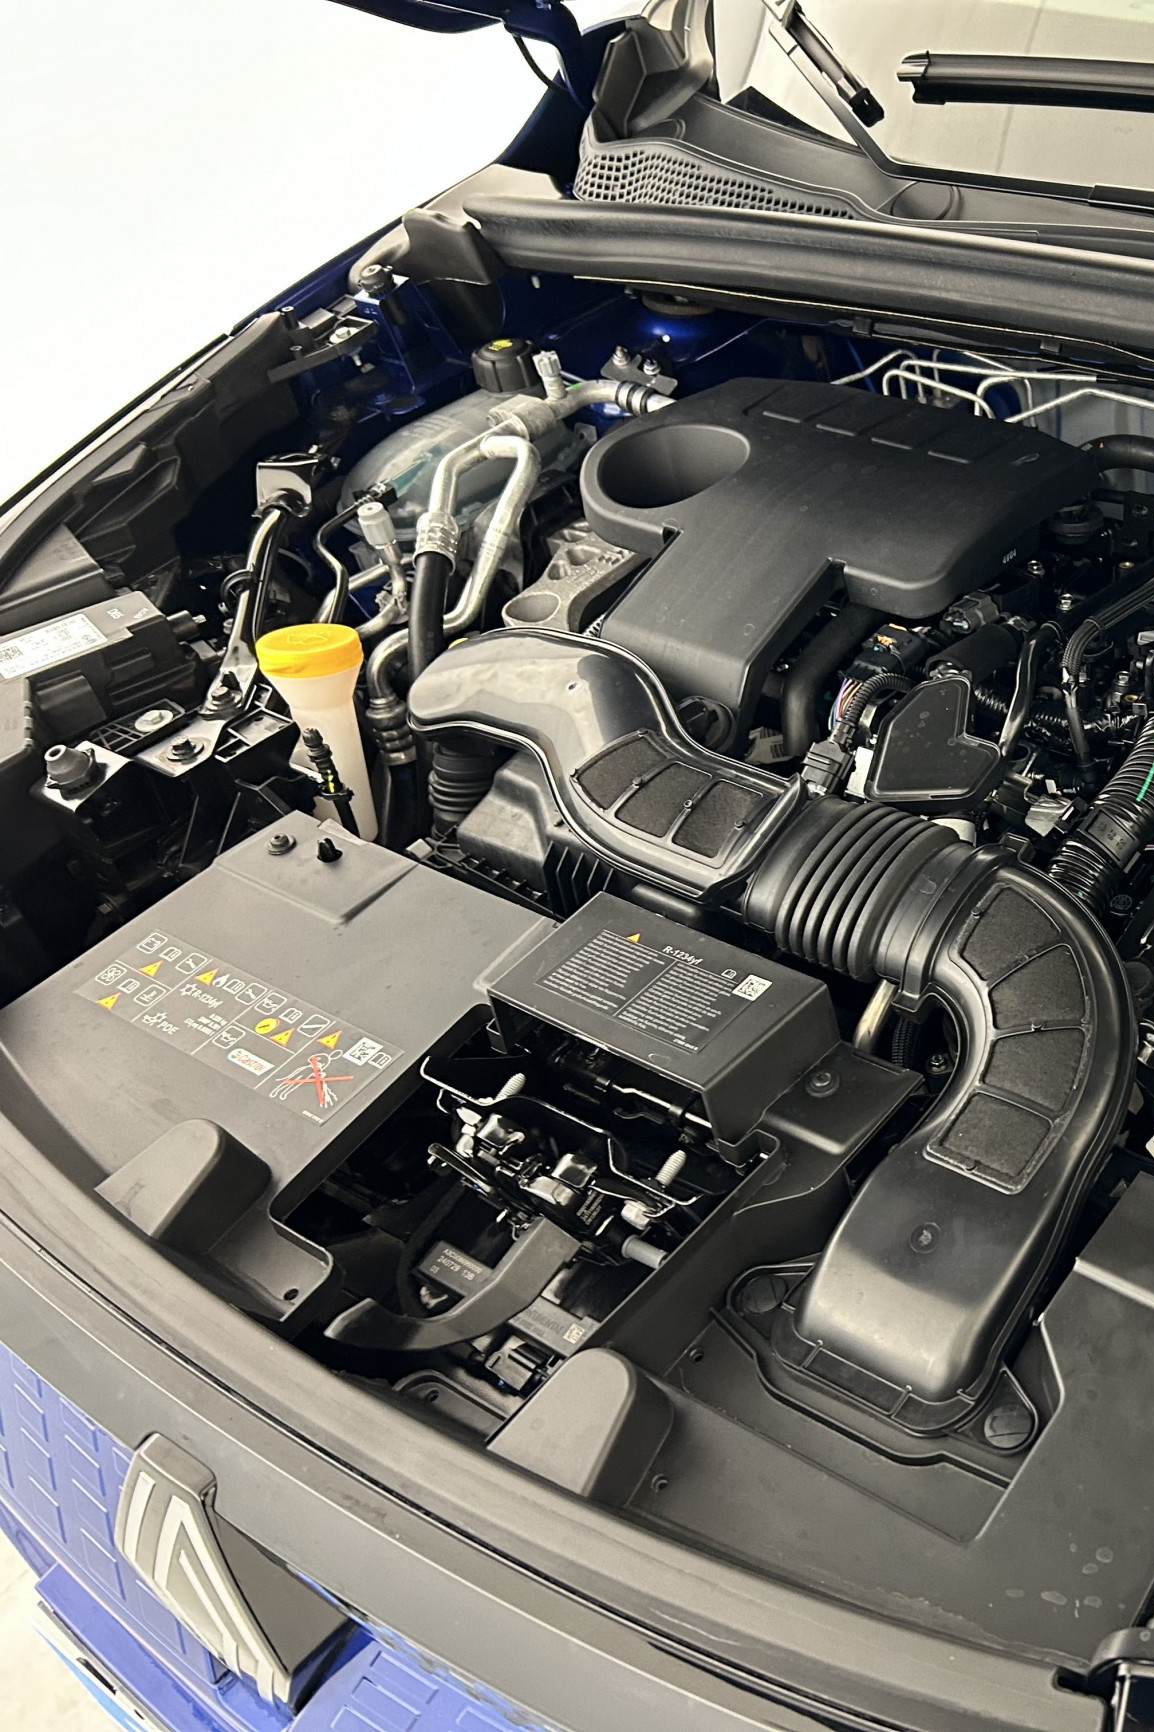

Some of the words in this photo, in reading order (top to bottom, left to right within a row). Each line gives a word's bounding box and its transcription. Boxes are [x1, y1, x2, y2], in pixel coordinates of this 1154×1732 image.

[662, 945, 704, 965] R-1234yf
[191, 989, 224, 1008] R-1234yf
[160, 1020, 180, 1036] POE
[237, 1053, 267, 1072] Castrol
